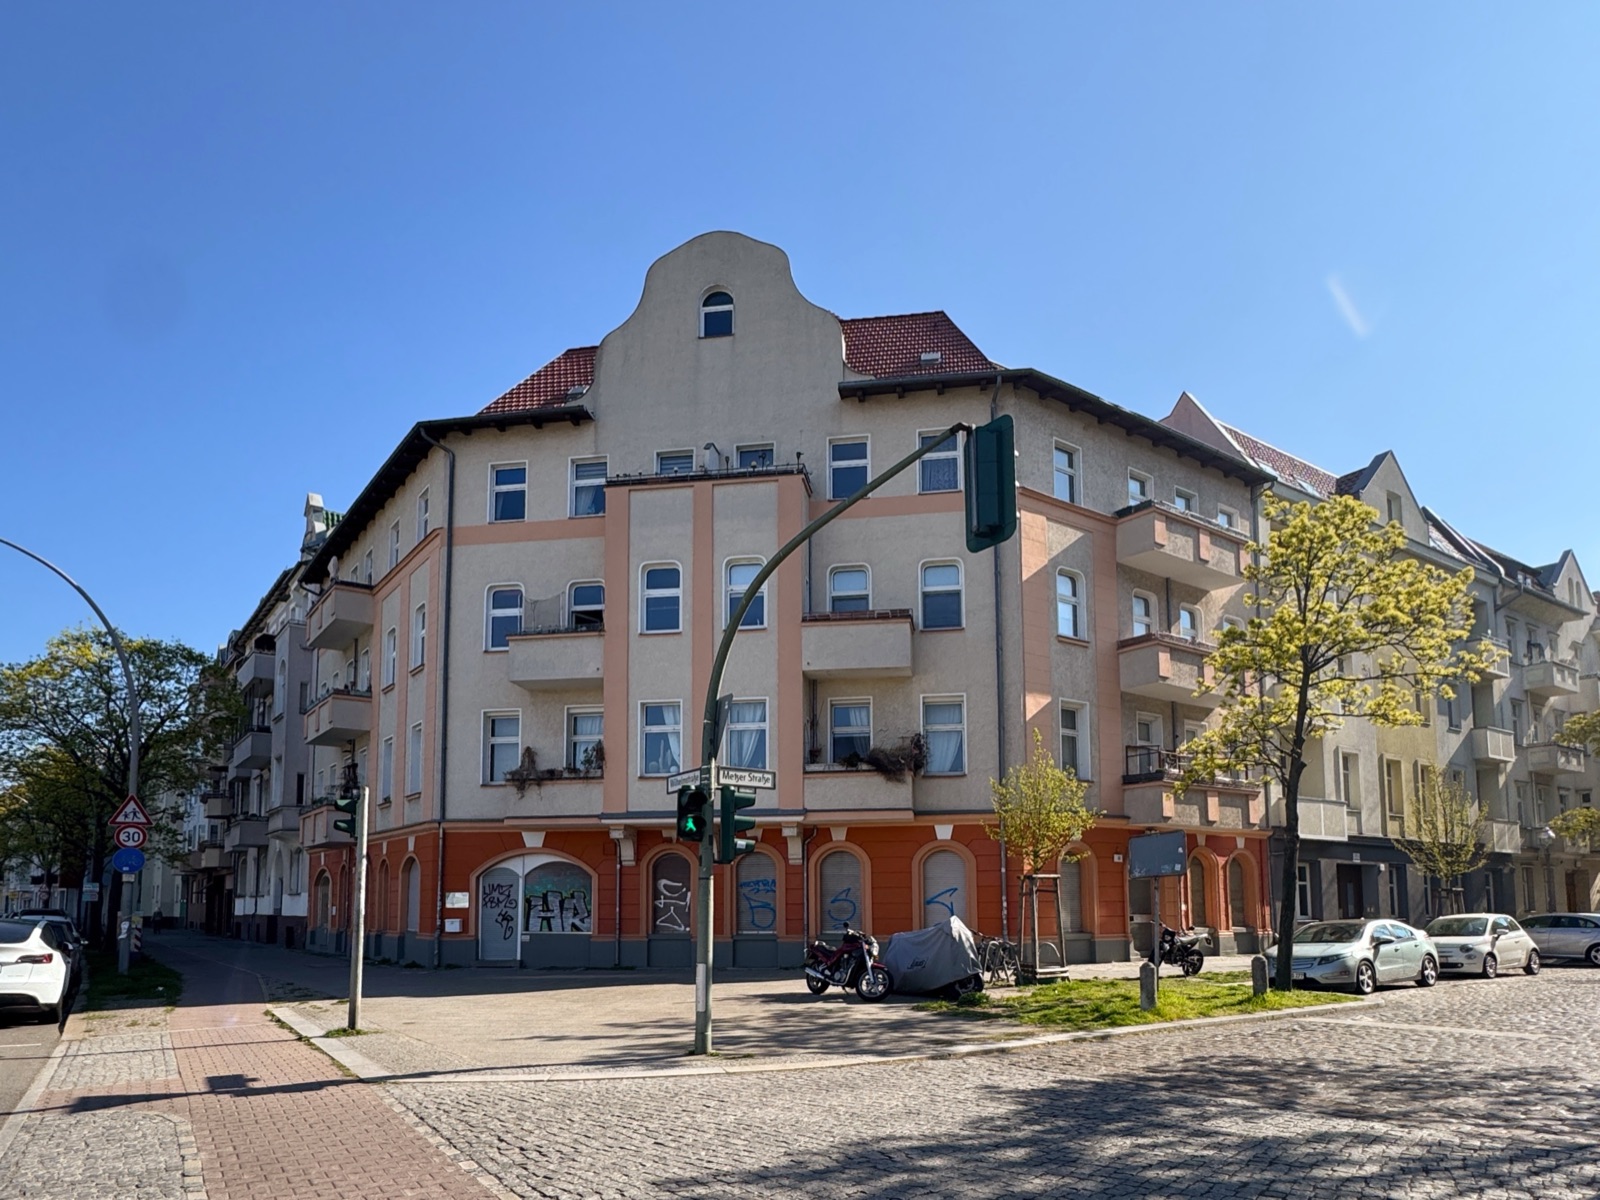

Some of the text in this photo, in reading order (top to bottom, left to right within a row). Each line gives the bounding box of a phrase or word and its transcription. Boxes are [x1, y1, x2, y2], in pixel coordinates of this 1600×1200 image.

[722, 770, 771, 785] Metzer Straße
[122, 831, 141, 843] 30
